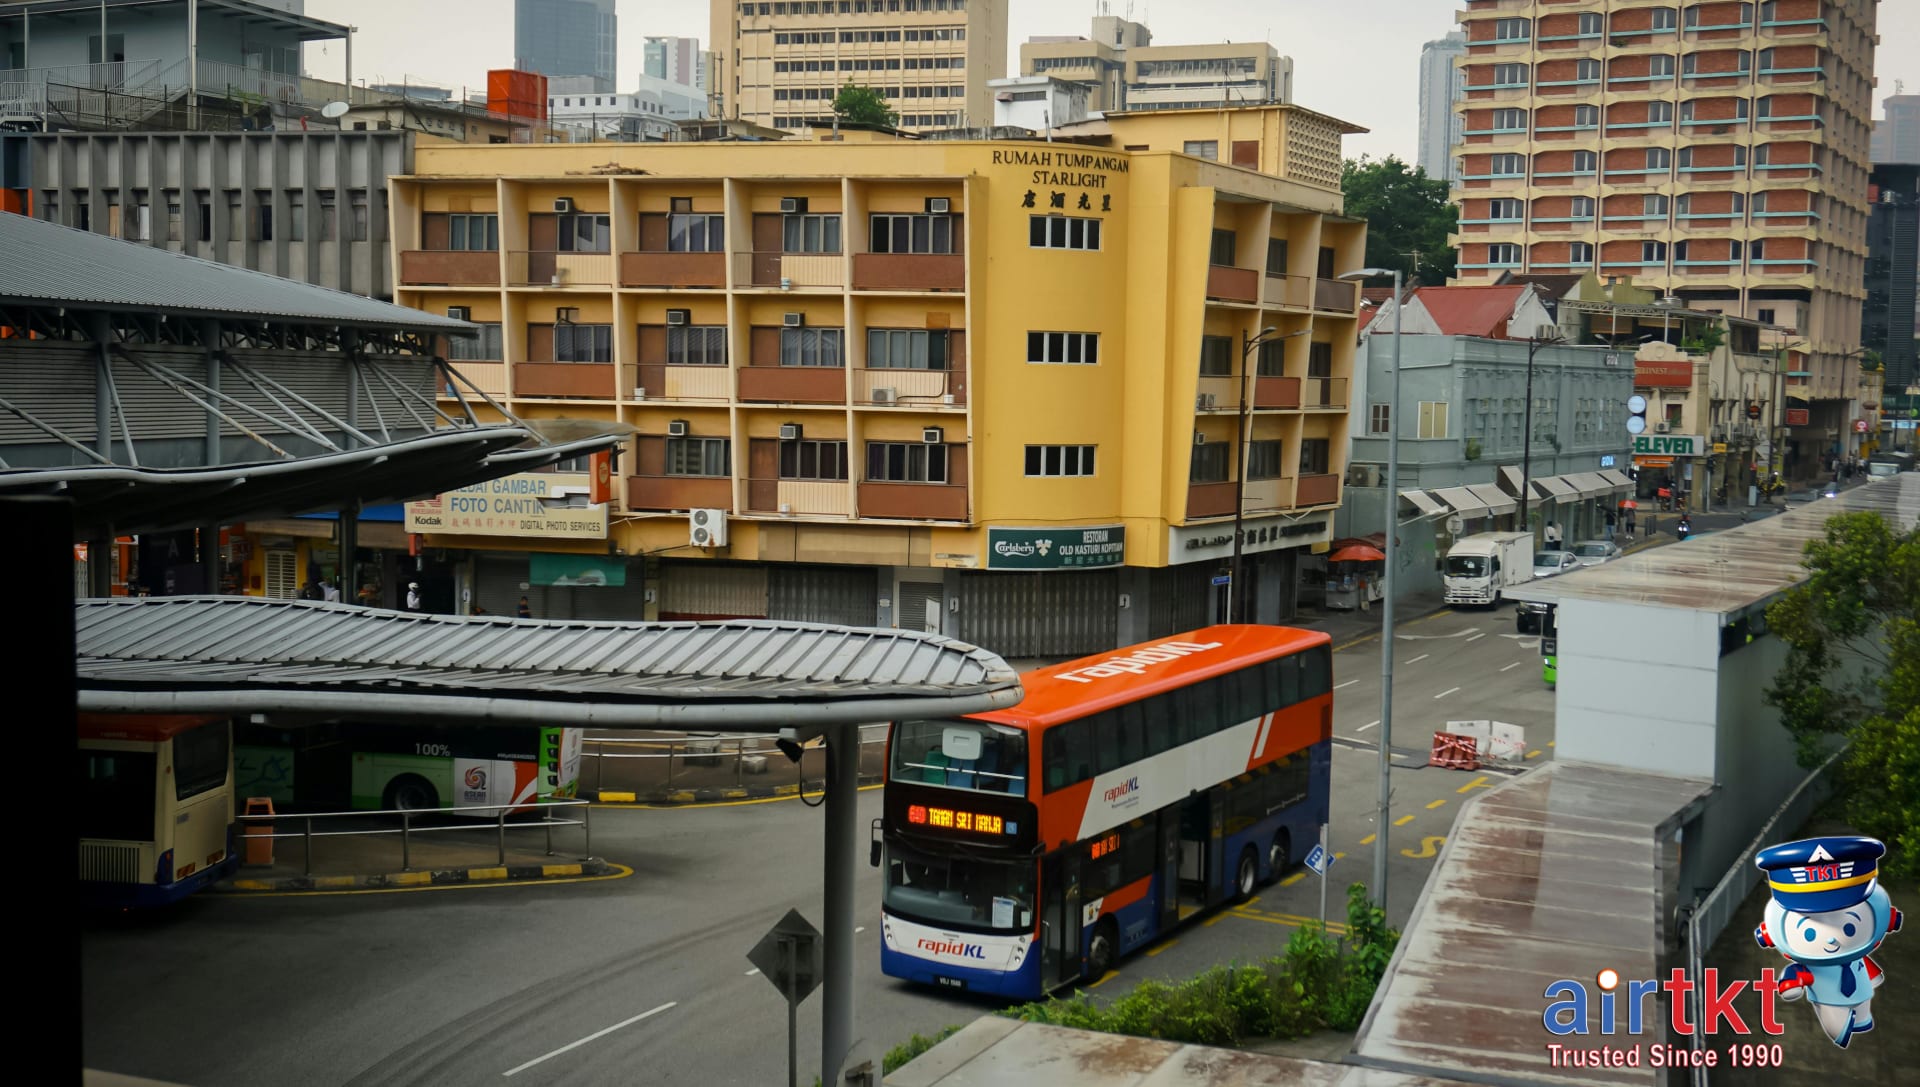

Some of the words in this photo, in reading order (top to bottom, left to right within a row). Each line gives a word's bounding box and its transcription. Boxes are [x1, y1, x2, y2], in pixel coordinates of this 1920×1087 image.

[992, 150, 1051, 166] RUMAH
[1055, 153, 1129, 173] TUMPANGAN
[1032, 170, 1107, 188] STARLIGHT
[492, 479, 546, 495] GAMBAR
[450, 497, 488, 513] FOTO
[494, 498, 545, 514] CANTIK
[414, 516, 442, 526] Kodak
[520, 520, 543, 530] DIGITAL
[546, 521, 567, 531] PHOTO
[570, 522, 600, 532] SERVICES
[1083, 530, 1109, 543] RESTORAN
[994, 541, 1035, 557] Carlsberg
[1059, 545, 1074, 556] OLD
[1075, 543, 1101, 556] KASTURI
[1053, 641, 1223, 683] rapidKL
[415, 743, 450, 757] 100%
[1103, 776, 1140, 802] rapidKL
[929, 808, 953, 828] TAMAN
[956, 812, 972, 830] SRI
[917, 938, 986, 960] rapidKL
